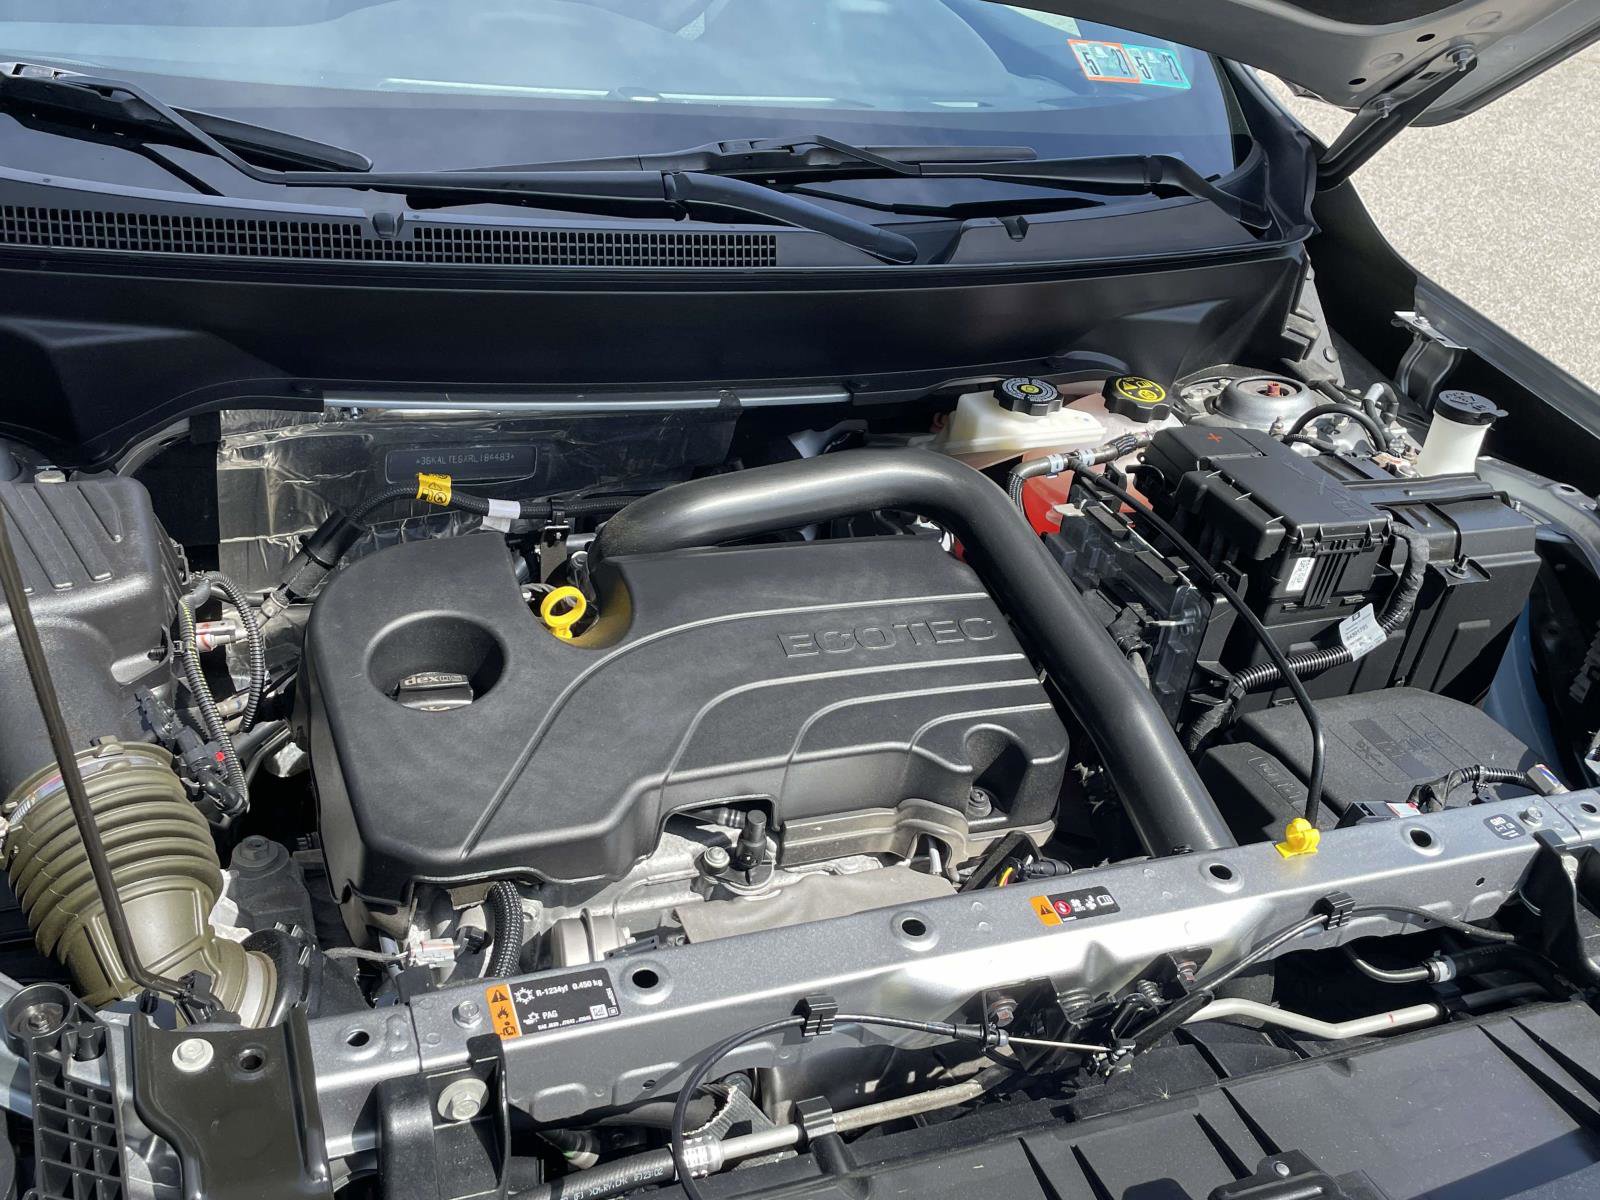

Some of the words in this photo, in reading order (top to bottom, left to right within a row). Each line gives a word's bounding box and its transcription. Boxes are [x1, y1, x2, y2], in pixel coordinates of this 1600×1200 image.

[1082, 51, 1100, 76] 5
[1134, 55, 1152, 80] 5
[776, 617, 998, 658] ECOTEC
[535, 984, 569, 997] R-1234yf
[572, 980, 593, 991] 0.450
[593, 979, 603, 987] kg
[542, 1010, 558, 1019] PAG
